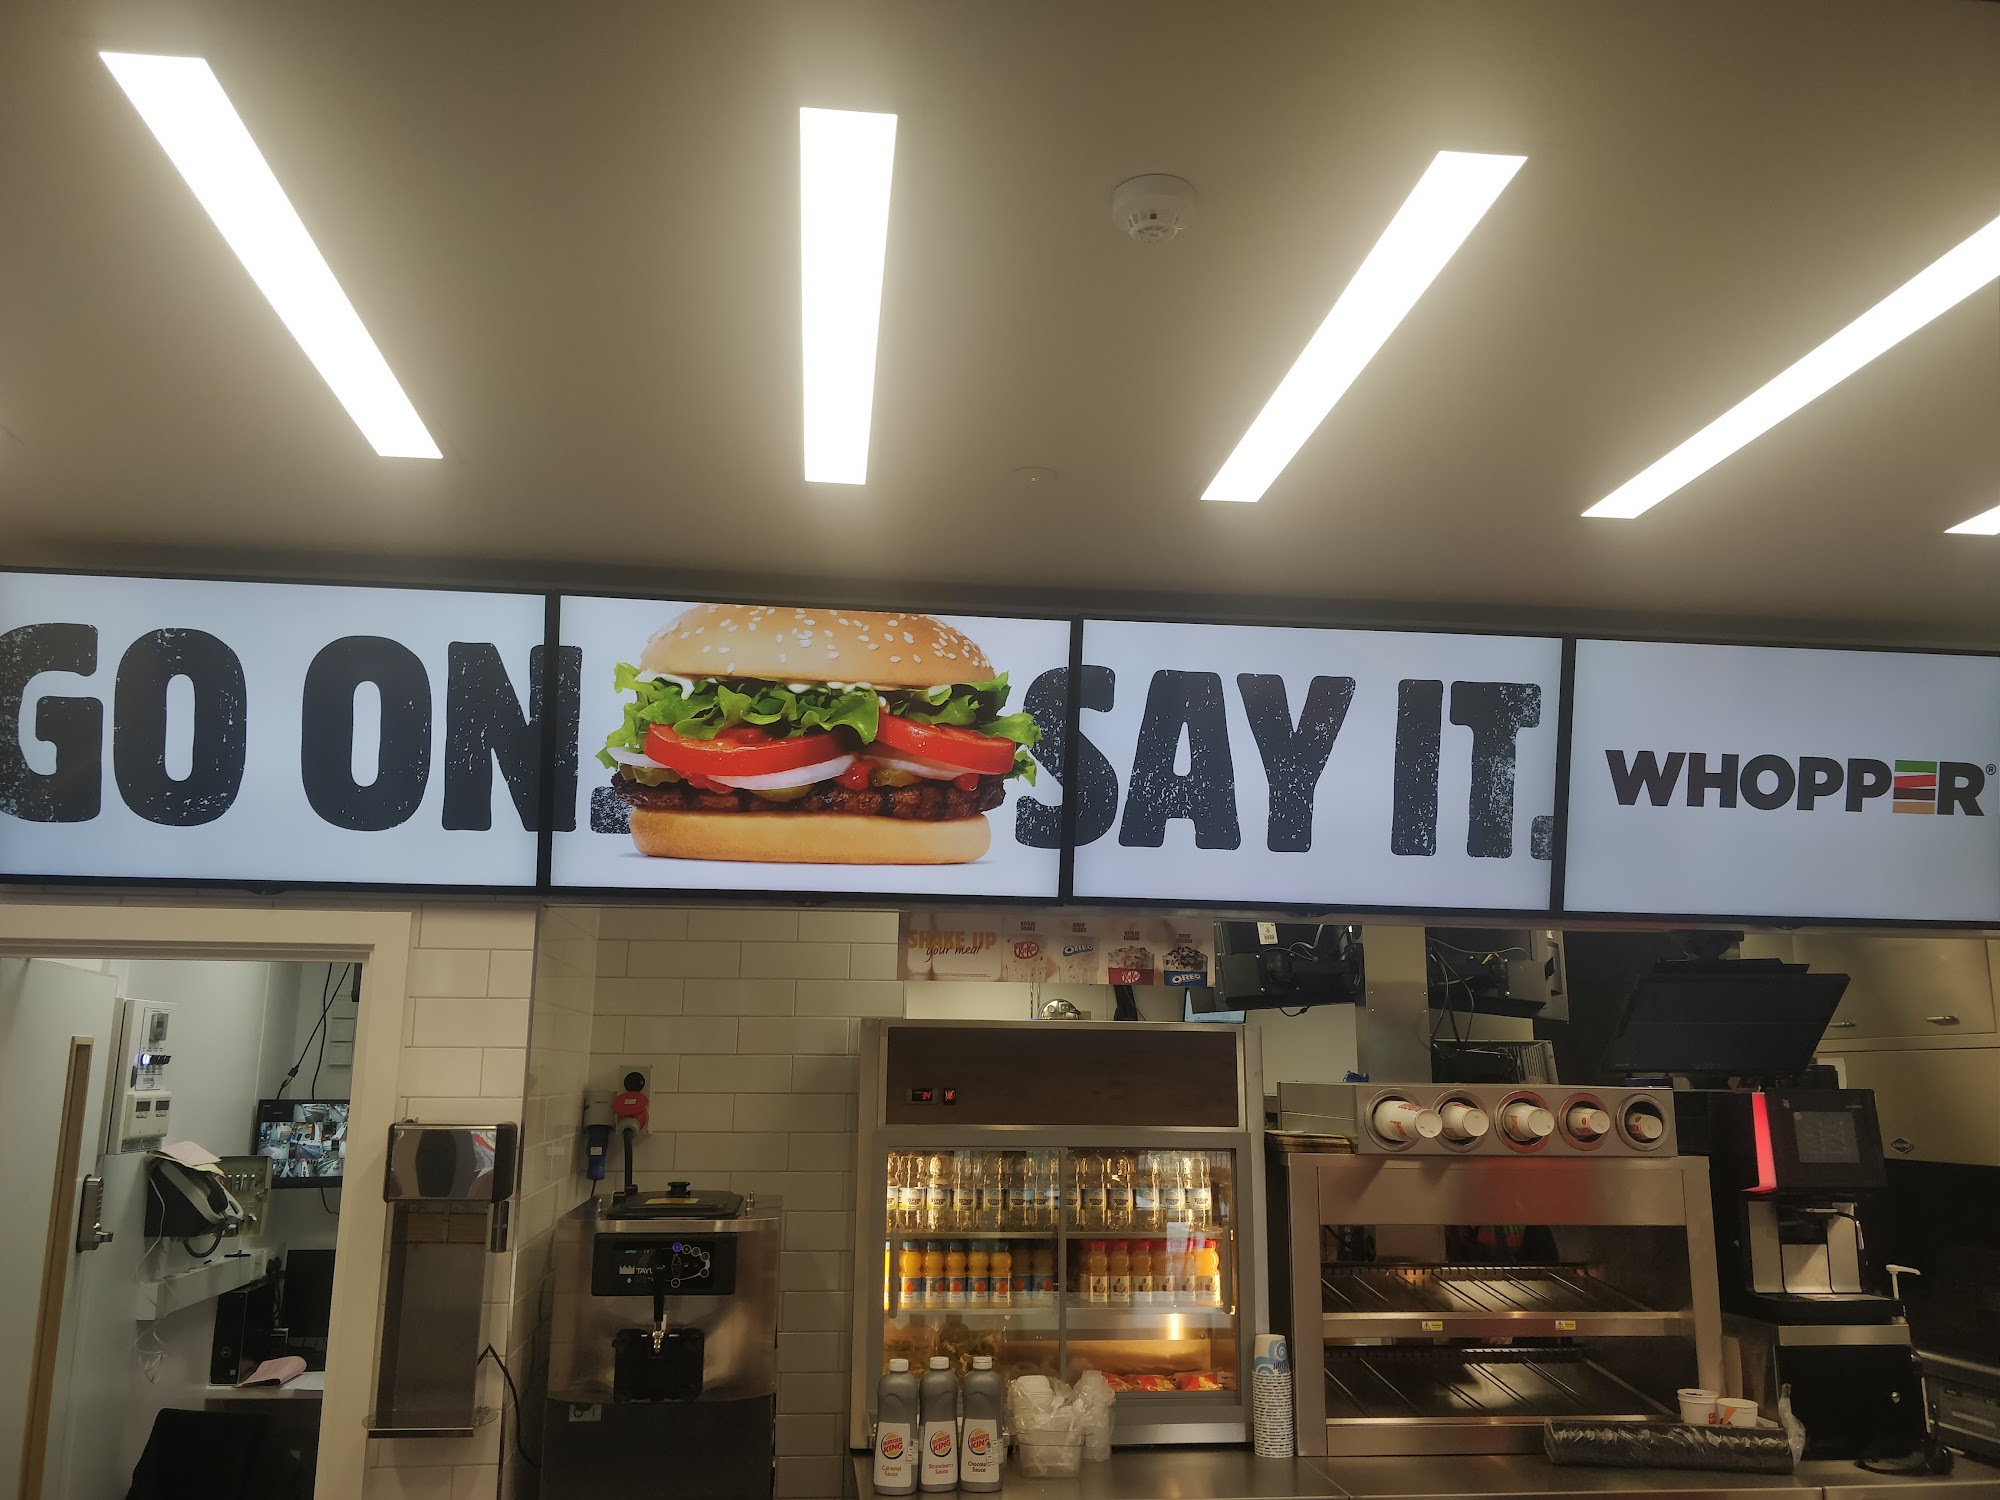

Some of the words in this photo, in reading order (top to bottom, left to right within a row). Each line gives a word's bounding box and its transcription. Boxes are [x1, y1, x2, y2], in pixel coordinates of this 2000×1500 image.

[0, 622, 247, 827] GO
[1015, 665, 1356, 852] SAY
[1390, 679, 1554, 860] IT.
[908, 930, 965, 949] SHAKE
[972, 931, 998, 950] UP
[925, 946, 952, 963] your
[954, 941, 981, 955] meal
[882, 1437, 903, 1446] BURGER
[932, 1434, 951, 1445] BURGER
[970, 1433, 990, 1443] BURGER
[883, 1442, 904, 1454] KING
[932, 1440, 952, 1452] KING
